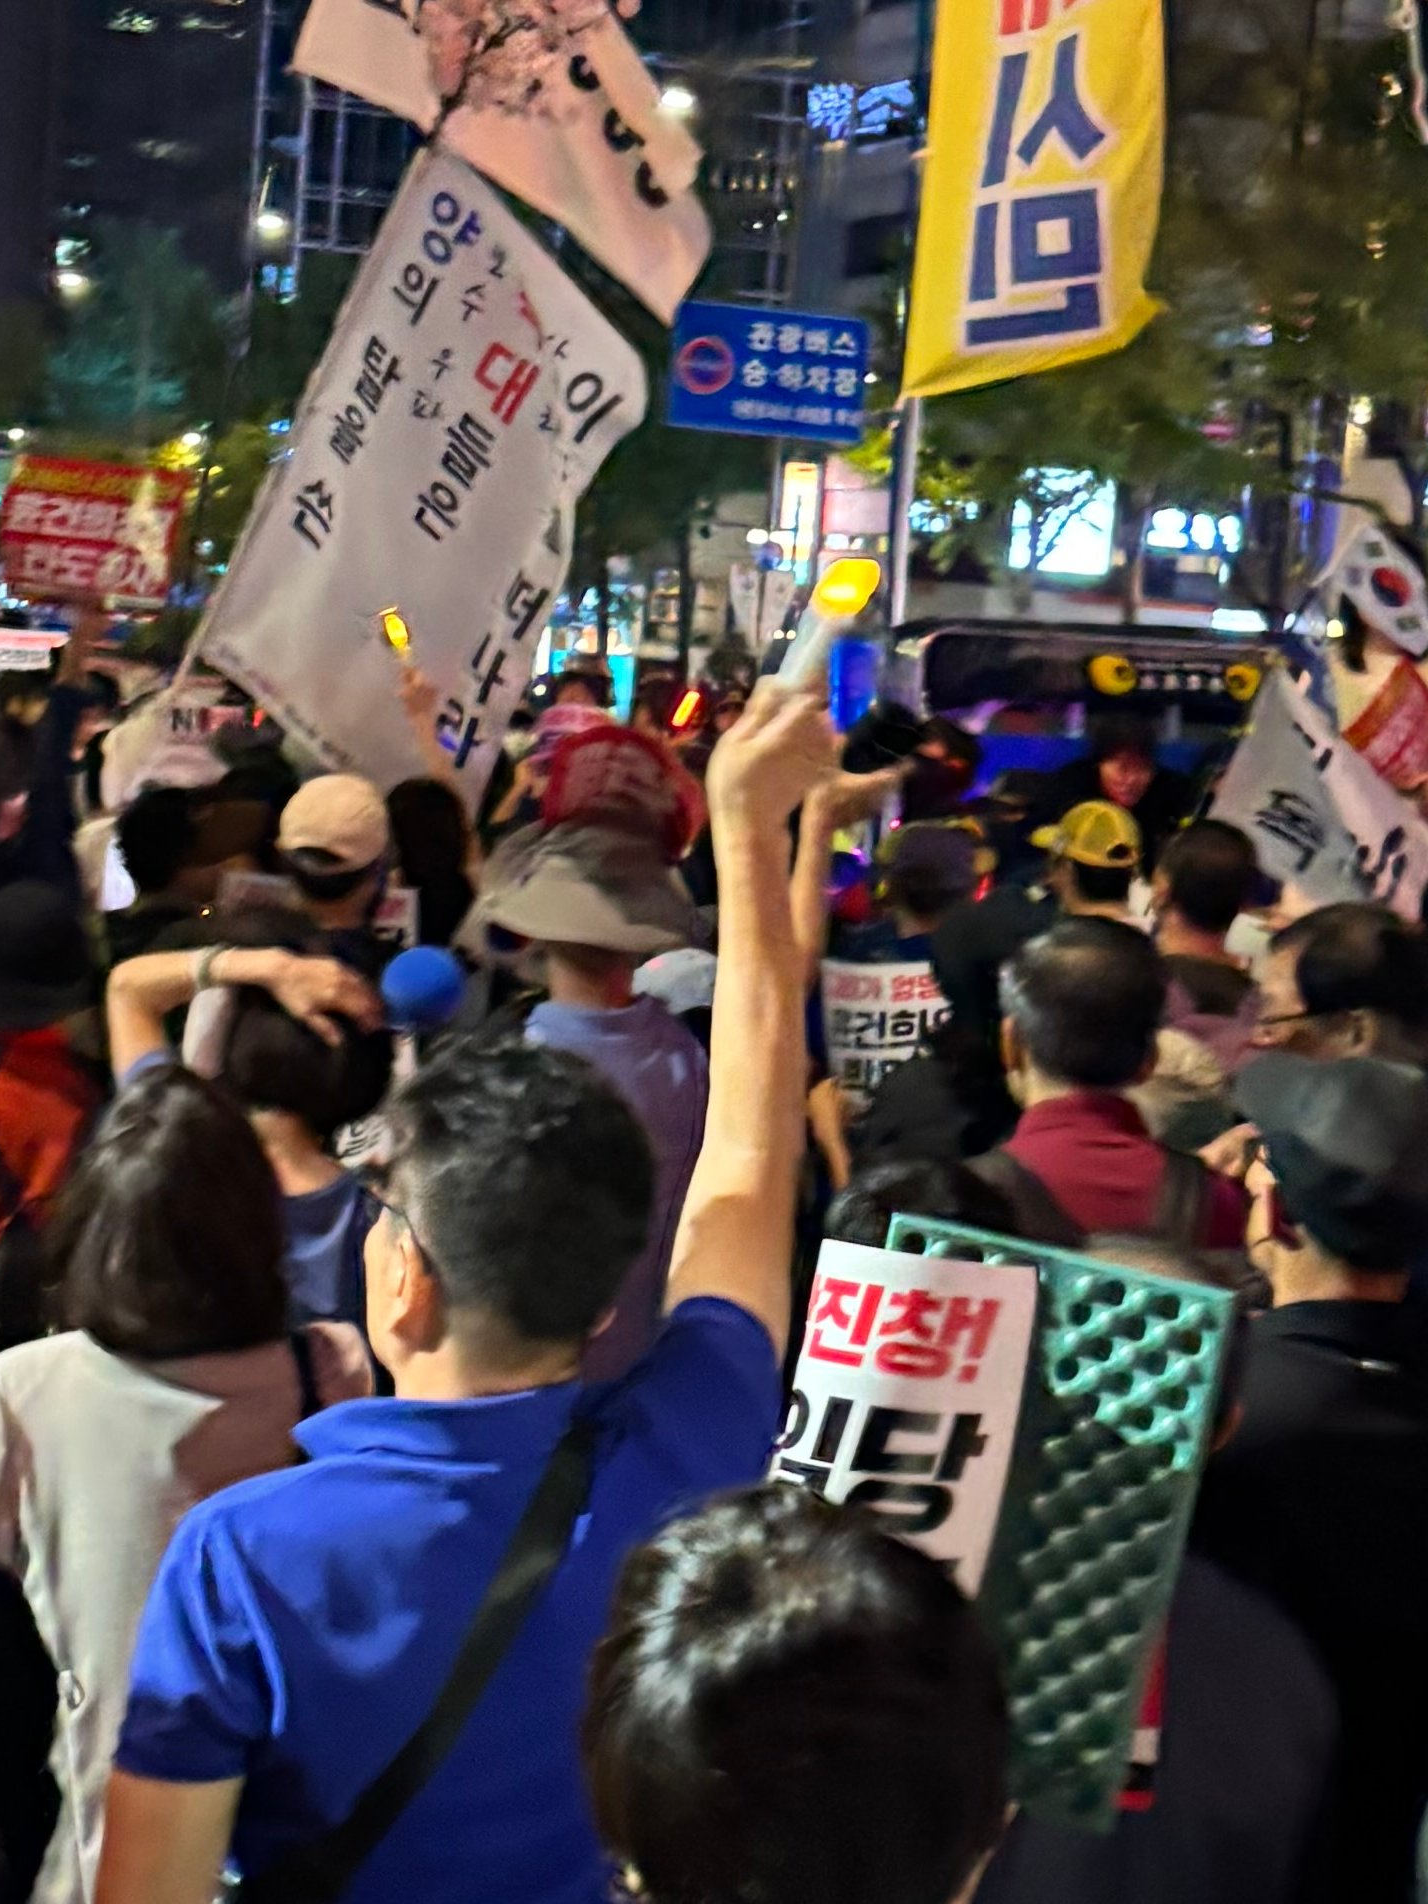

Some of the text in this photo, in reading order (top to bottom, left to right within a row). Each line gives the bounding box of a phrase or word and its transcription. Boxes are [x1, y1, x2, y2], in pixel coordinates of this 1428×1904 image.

[746, 320, 858, 357] 관광버스
[414, 291, 546, 542] 대들은
[807, 1274, 1003, 1383] 진창!
